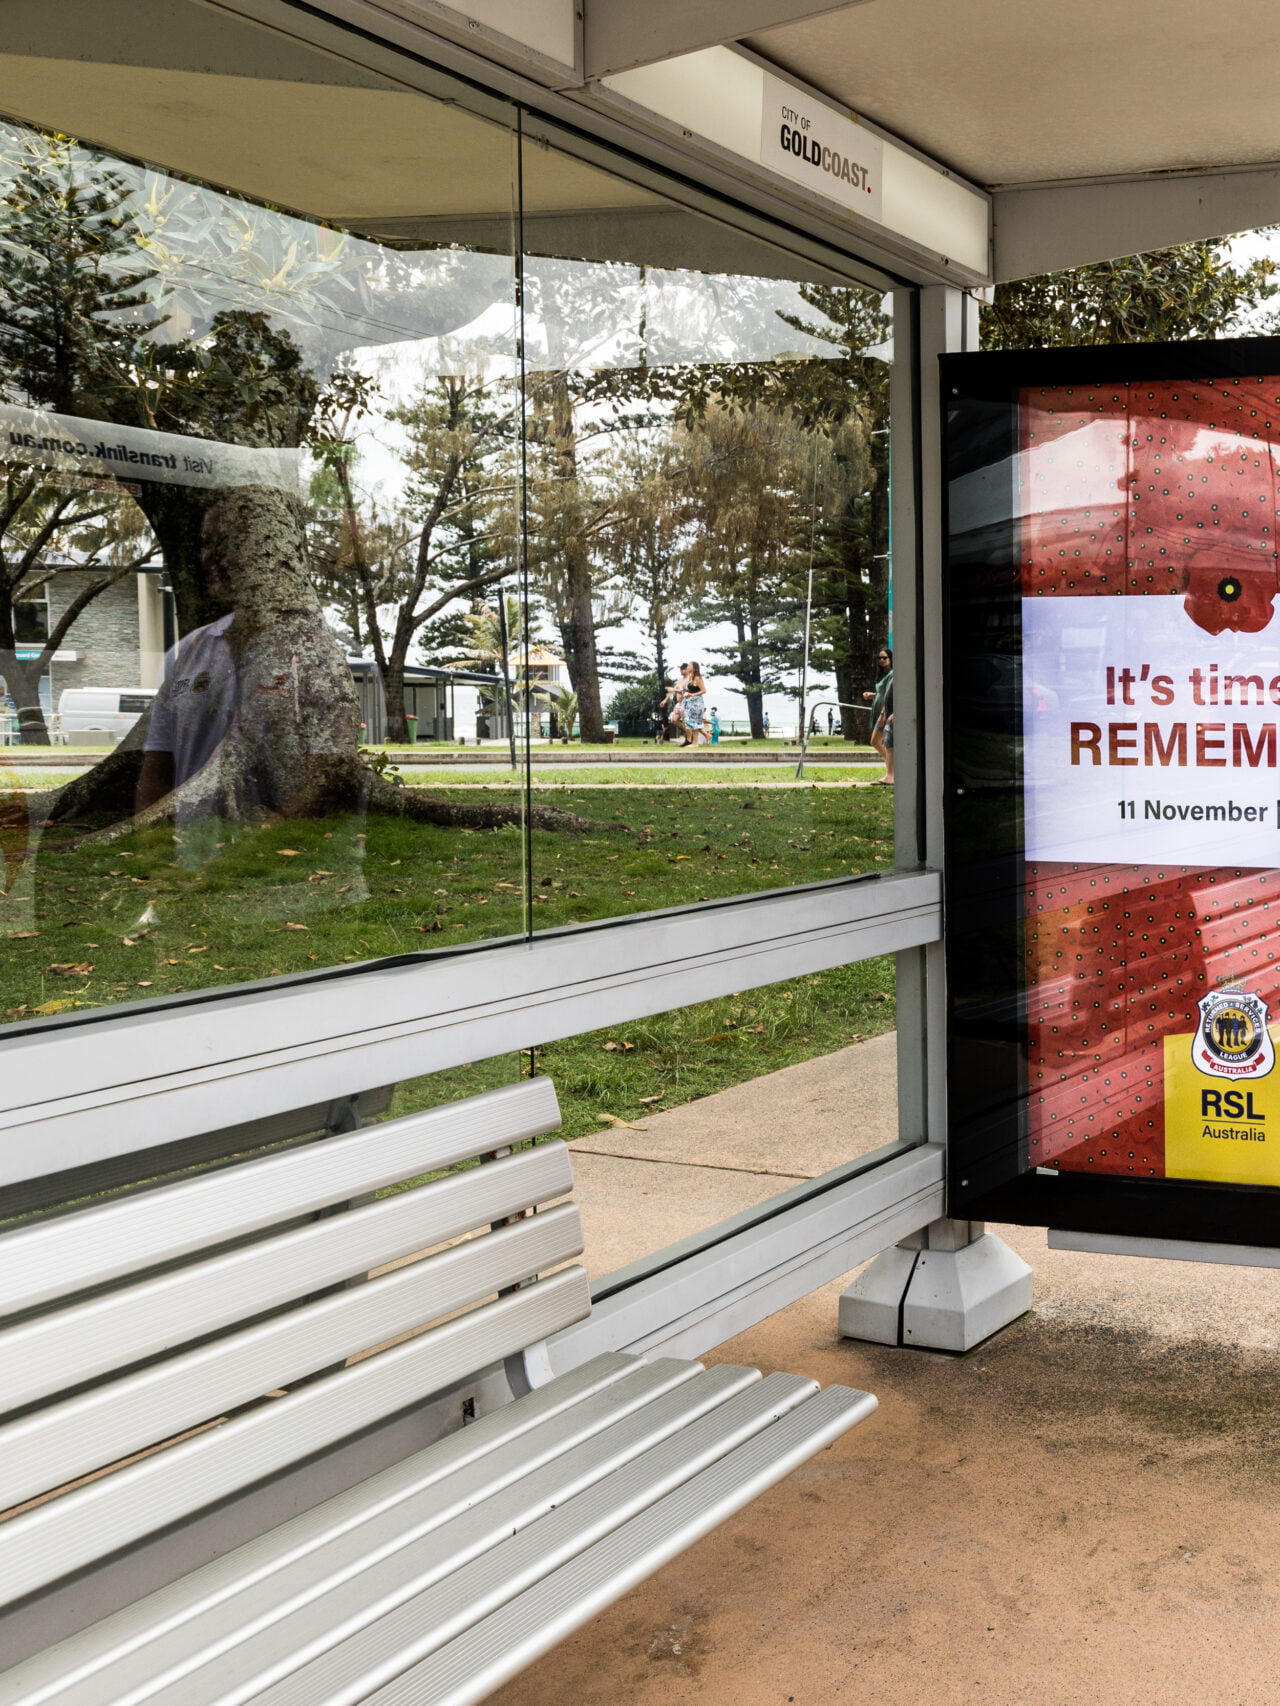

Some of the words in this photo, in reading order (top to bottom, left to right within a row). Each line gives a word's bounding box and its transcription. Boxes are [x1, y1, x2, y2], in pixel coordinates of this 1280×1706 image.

[781, 105, 799, 125] CITY
[800, 116, 811, 131] OF
[1106, 664, 1176, 706] It's
[1117, 800, 1136, 820] 11
[1144, 799, 1268, 822] November
[1205, 1002, 1229, 1033] RETURNED
[1235, 1002, 1261, 1033] SERVICES
[1219, 1051, 1248, 1061] LEAGUE
[1213, 1064, 1254, 1073] AUSTRALIA
[1201, 1089, 1266, 1121] RSL
[1202, 1125, 1266, 1142] Australia
